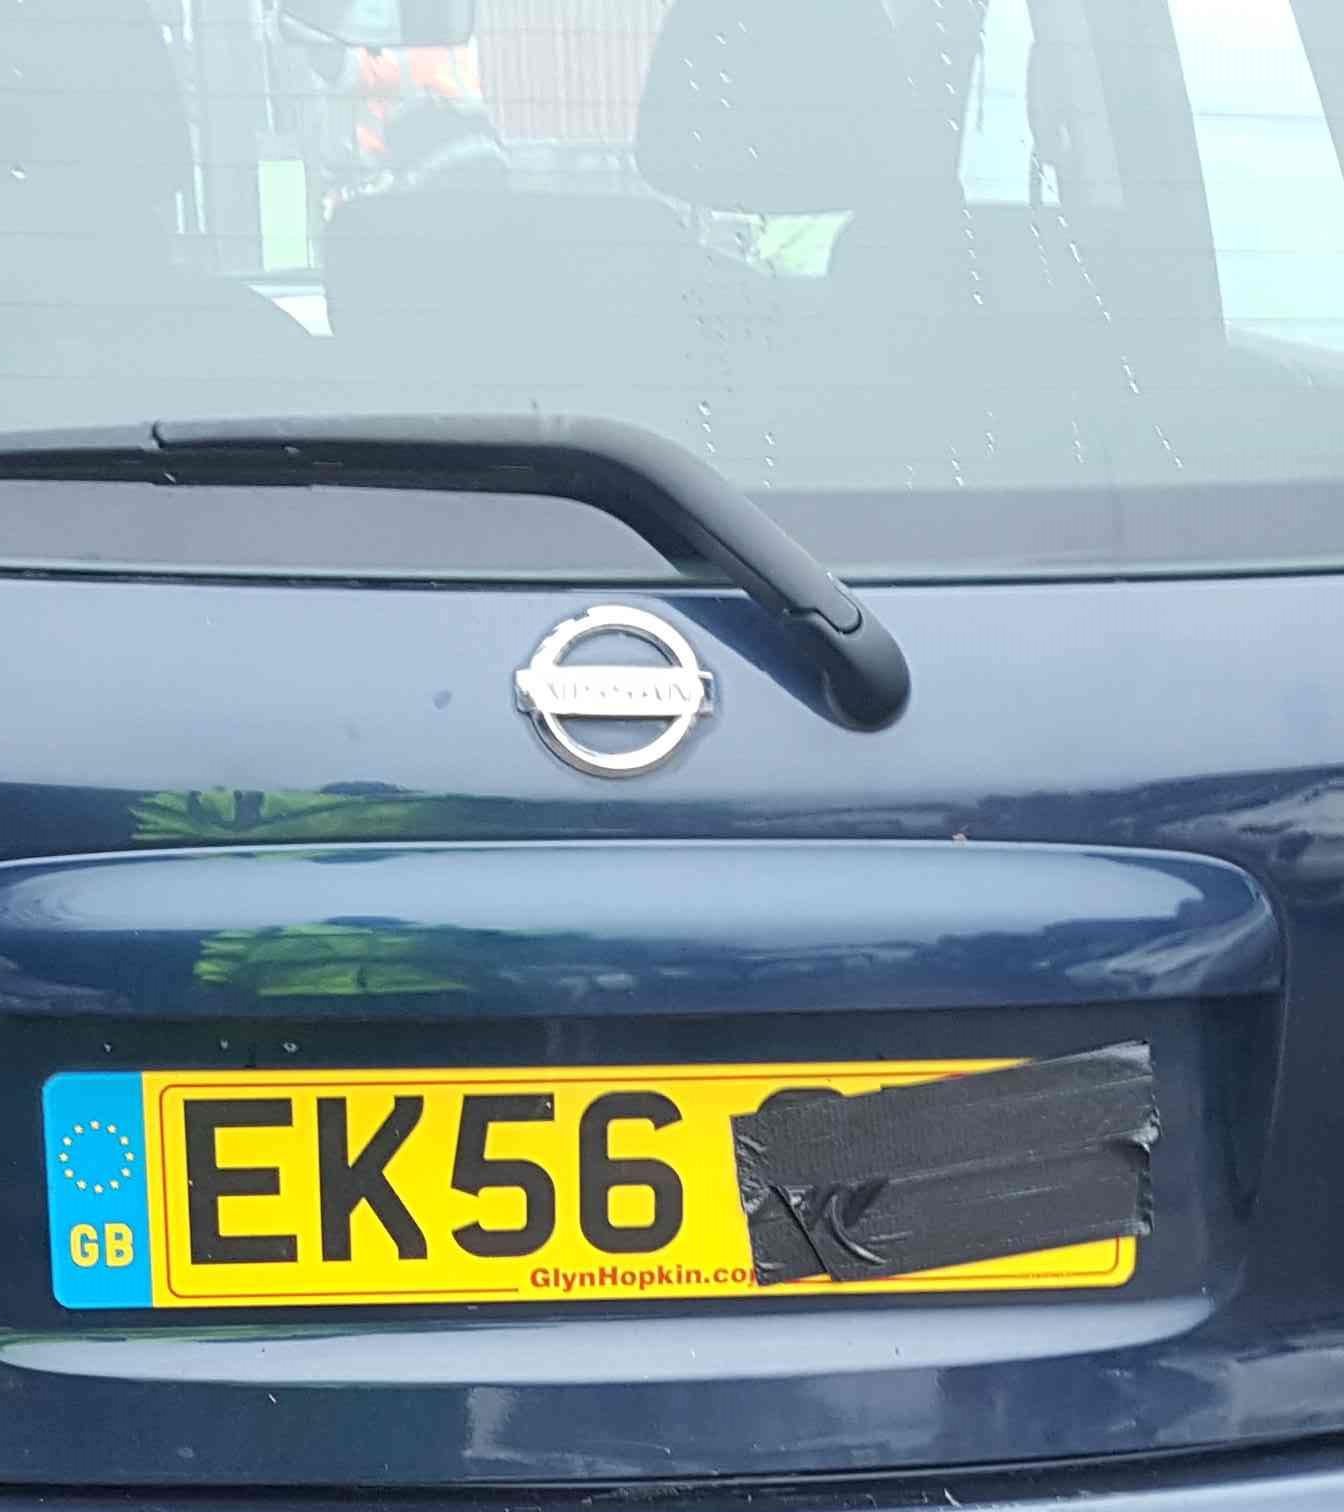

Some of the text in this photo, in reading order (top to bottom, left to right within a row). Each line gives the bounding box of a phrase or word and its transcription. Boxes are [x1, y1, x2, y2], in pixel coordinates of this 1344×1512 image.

[182, 1091, 683, 1265] EK56
[70, 1222, 134, 1268] GB
[529, 1264, 758, 1292] GlynHopkin.co
